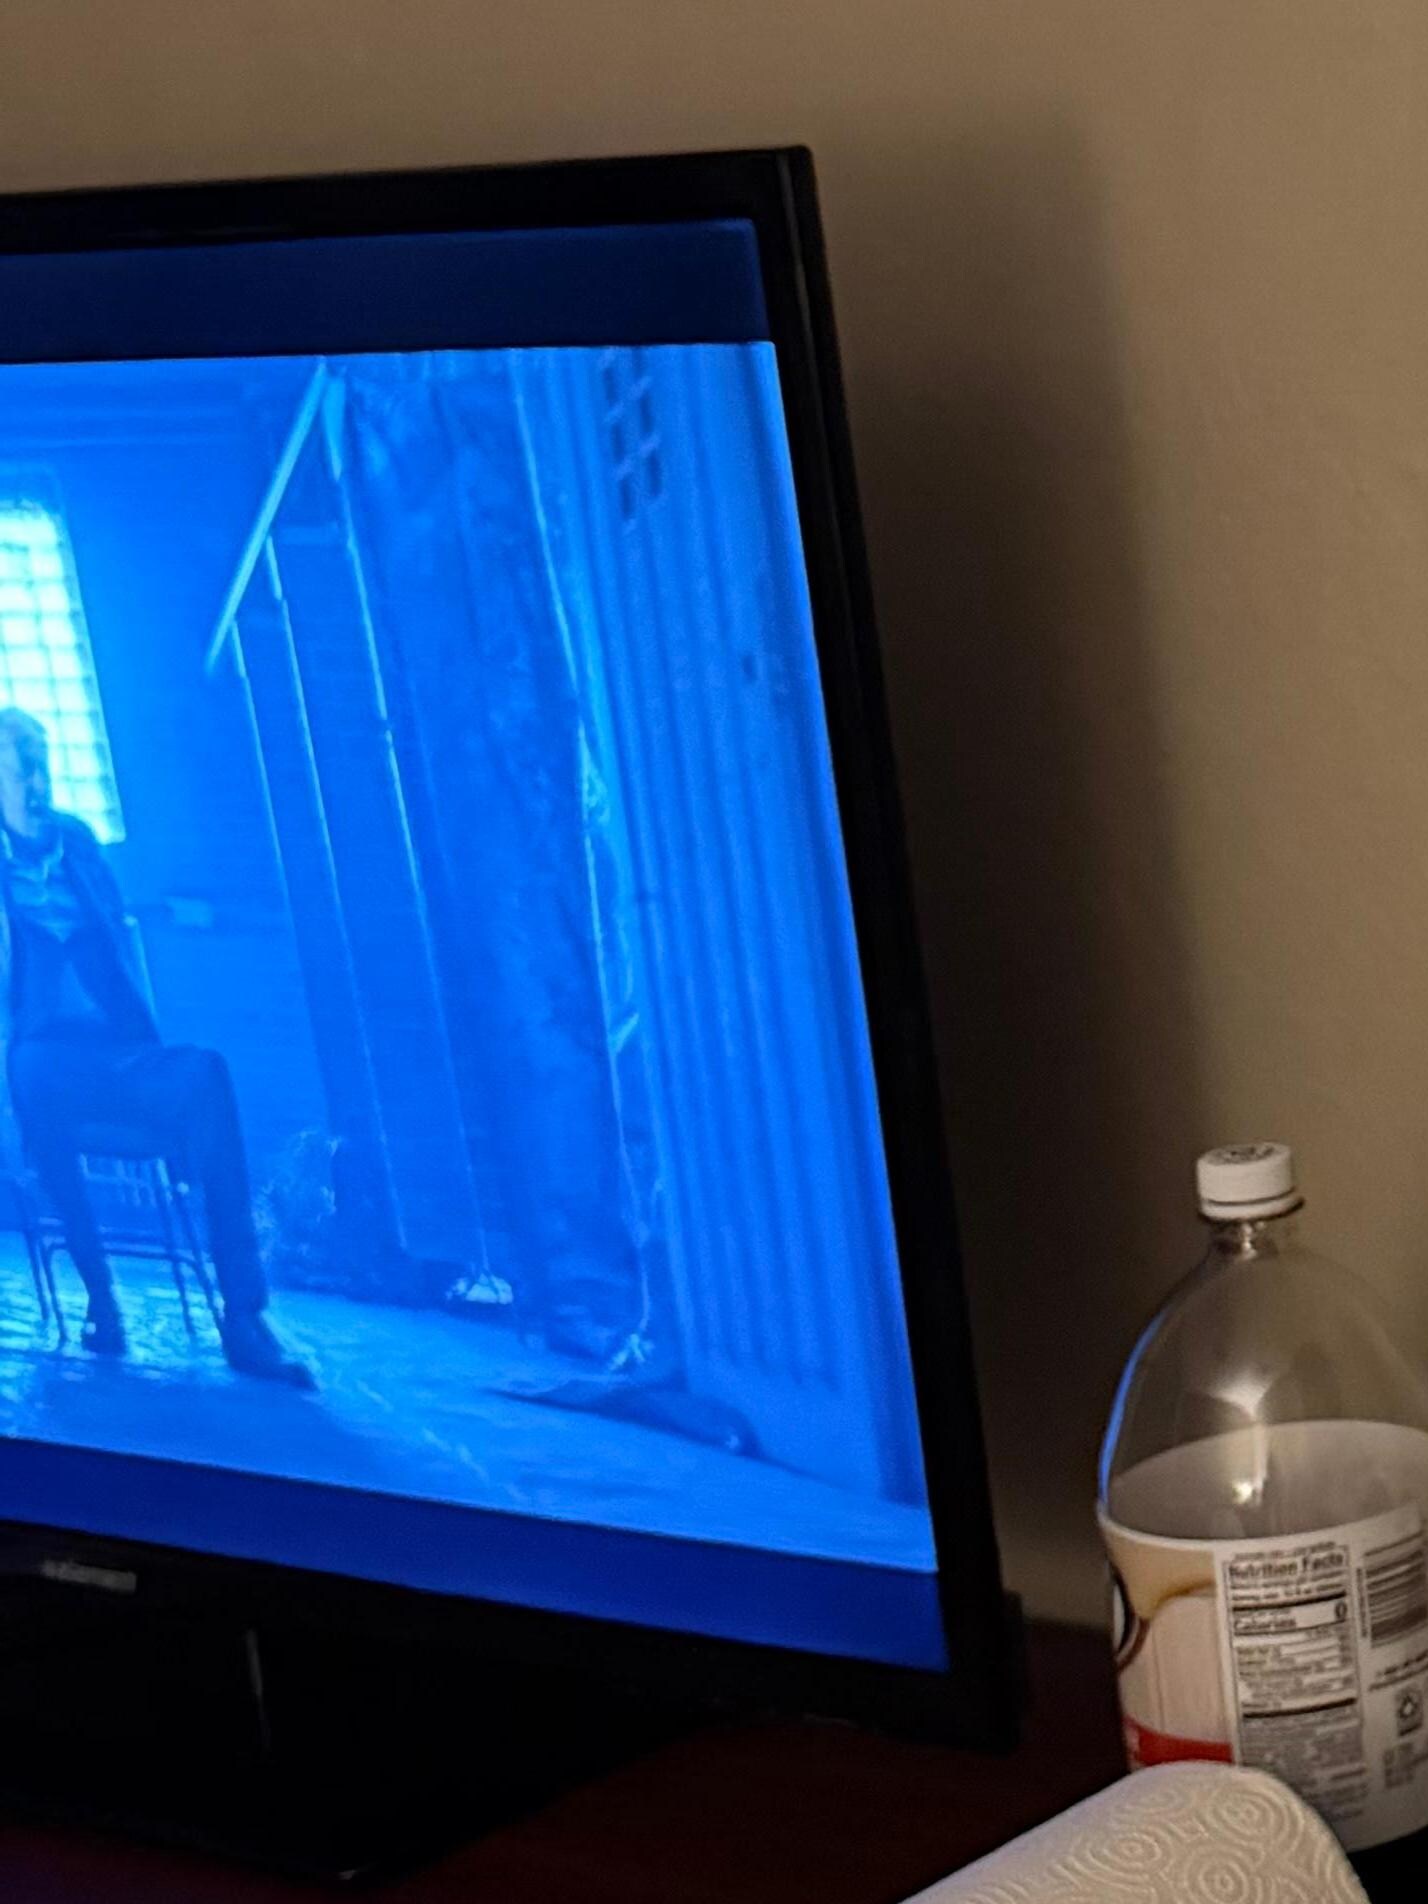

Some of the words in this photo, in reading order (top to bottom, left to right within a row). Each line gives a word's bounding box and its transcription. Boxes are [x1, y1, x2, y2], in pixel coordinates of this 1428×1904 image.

[1229, 1560, 1298, 1579] Nutrition
[1302, 1552, 1345, 1572] Facts
[1233, 1616, 1296, 1632] Calories
[1334, 1600, 1348, 1620] 0
